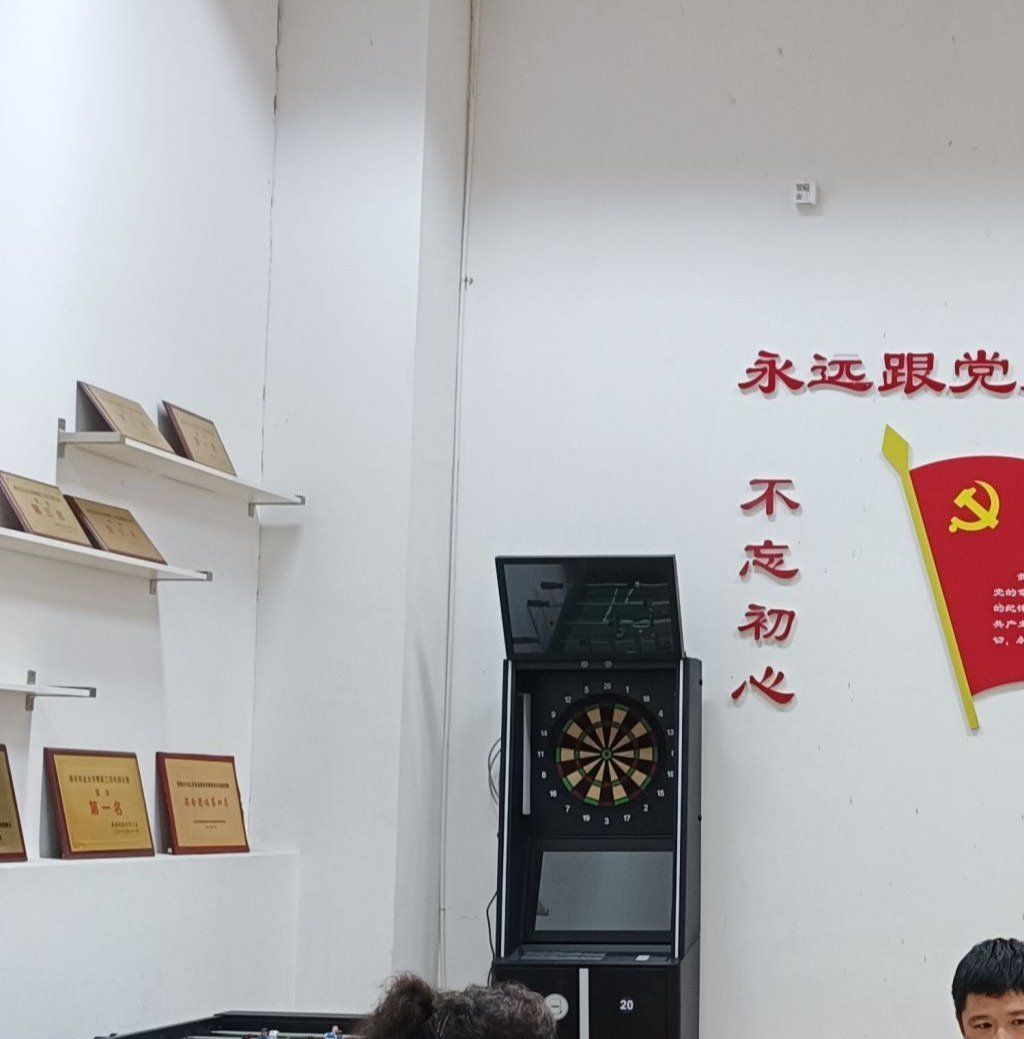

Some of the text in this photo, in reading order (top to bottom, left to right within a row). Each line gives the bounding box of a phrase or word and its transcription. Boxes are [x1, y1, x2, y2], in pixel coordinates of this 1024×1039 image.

[733, 479, 800, 704] 不忘初心
[619, 999, 634, 1011] 20
